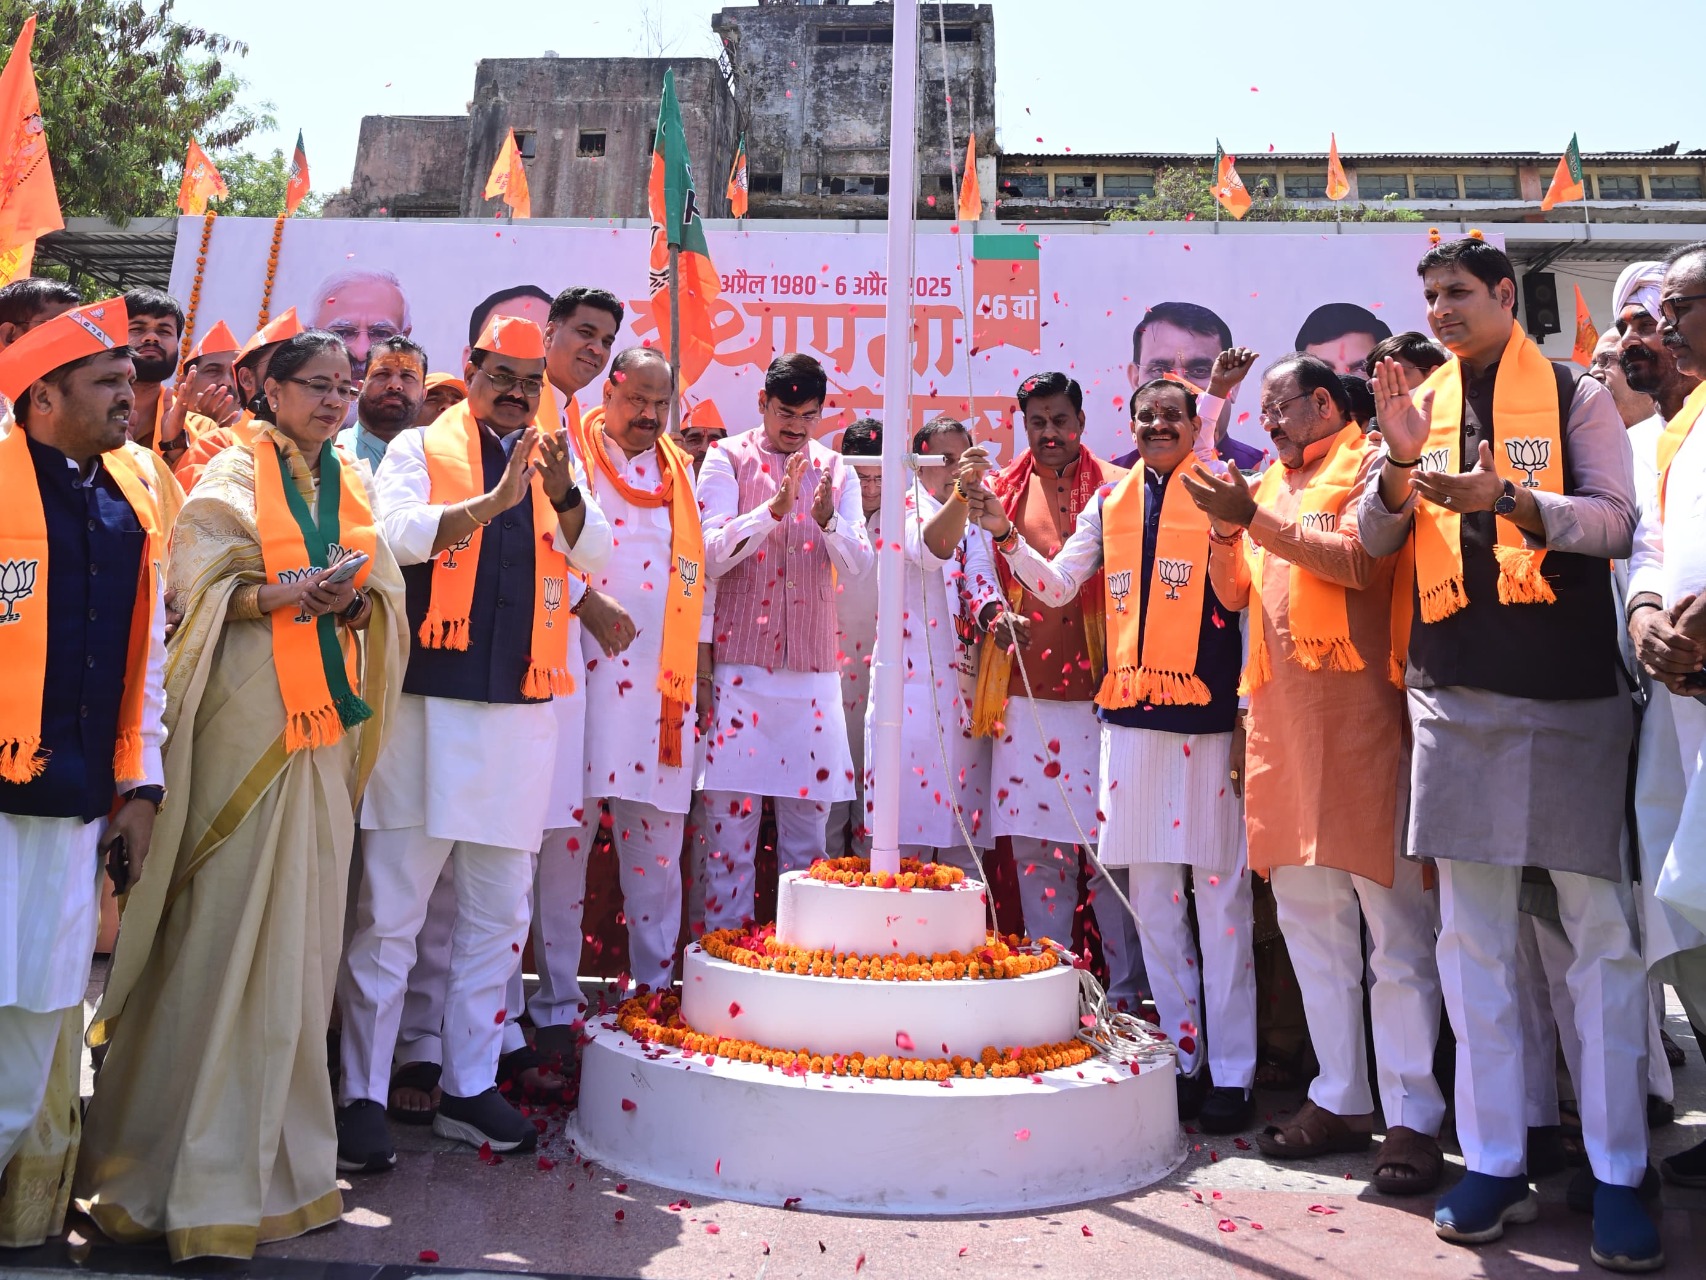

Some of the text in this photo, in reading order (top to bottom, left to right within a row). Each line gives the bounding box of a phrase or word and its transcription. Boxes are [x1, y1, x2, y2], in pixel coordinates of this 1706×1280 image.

[719, 268, 767, 295] अप्रैल
[770, 274, 817, 296] 1980
[834, 275, 847, 296] 6
[909, 276, 952, 297] 025
[975, 288, 1038, 320] 46 वां
